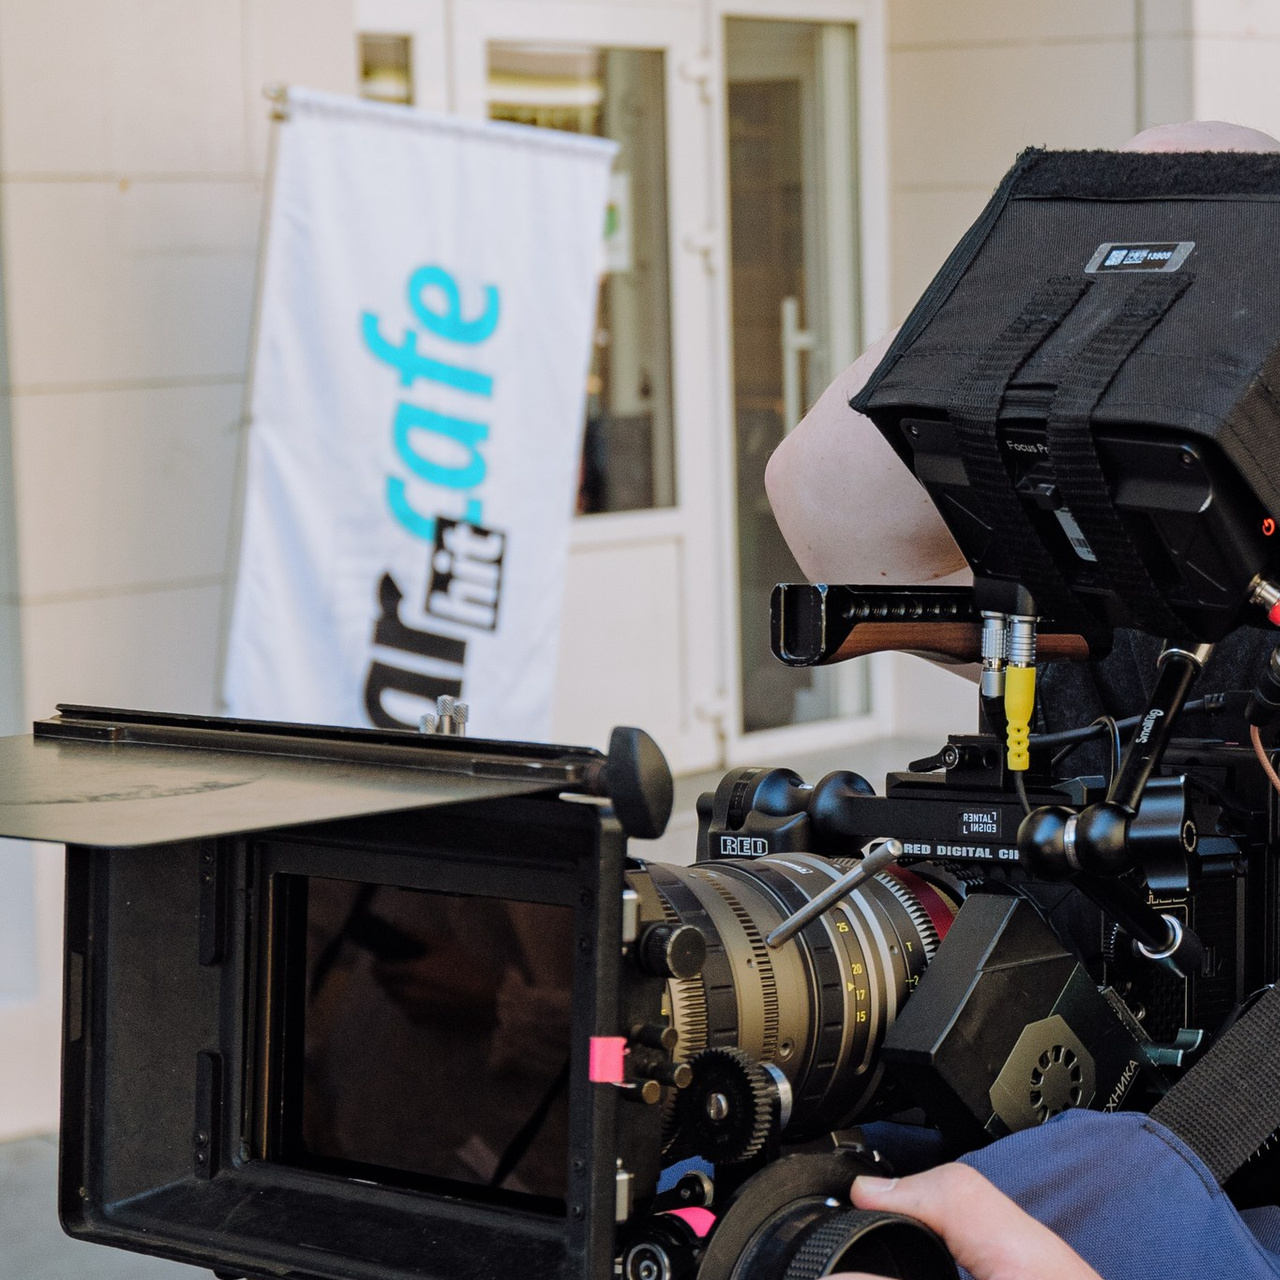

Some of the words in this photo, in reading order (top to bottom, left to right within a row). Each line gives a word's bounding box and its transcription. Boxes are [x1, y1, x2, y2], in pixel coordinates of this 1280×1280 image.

[361, 265, 500, 541] cafe
[1006, 440, 1037, 452] Focus
[427, 521, 505, 630] hit
[720, 836, 768, 856] RED
[903, 843, 931, 855] RED
[936, 845, 993, 858] DIGITAL
[836, 922, 849, 932] 25
[851, 964, 862, 974] 20
[856, 989, 865, 1000] 17
[856, 1011, 866, 1022] 15
